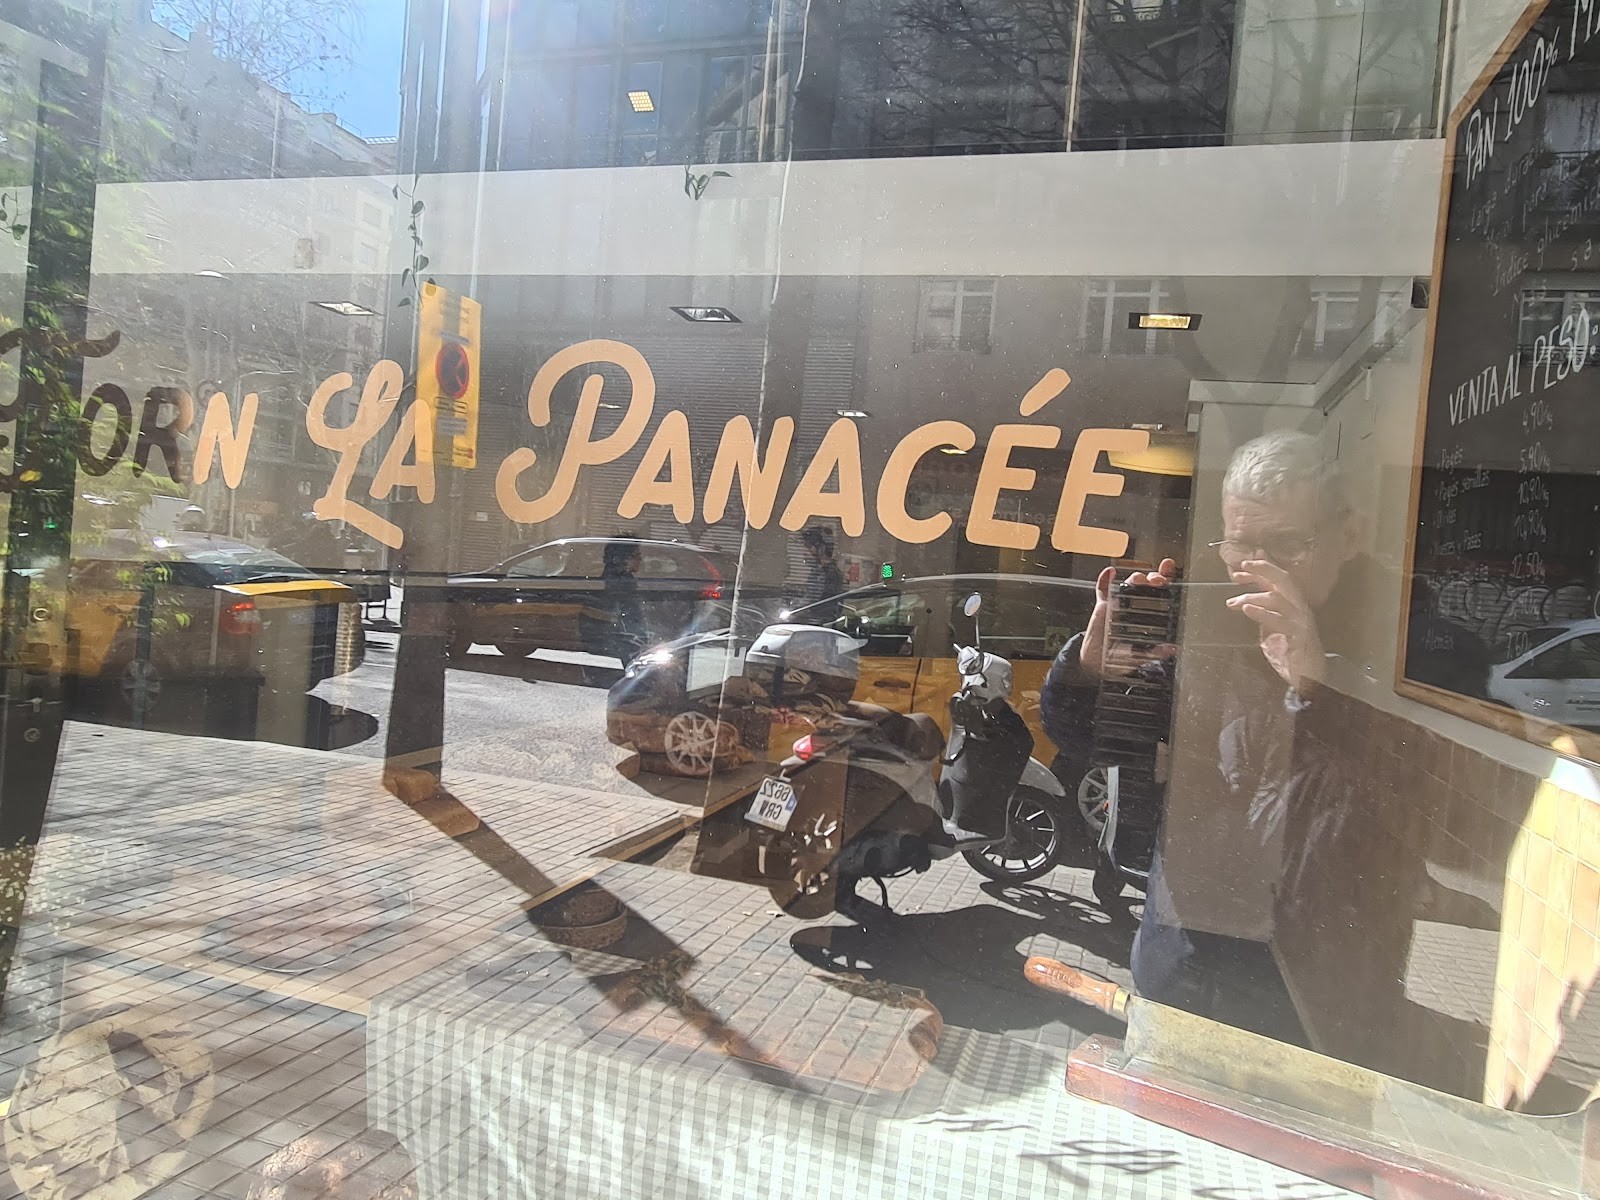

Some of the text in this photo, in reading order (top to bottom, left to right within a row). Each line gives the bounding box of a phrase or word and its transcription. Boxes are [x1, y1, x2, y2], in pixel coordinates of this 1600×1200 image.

[1465, 0, 1600, 190] PAN 100% M
[306, 360, 436, 550] LA
[496, 339, 1150, 558] PANACÉE
[1449, 365, 1500, 427] VENTA
[1501, 352, 1522, 405] AL
